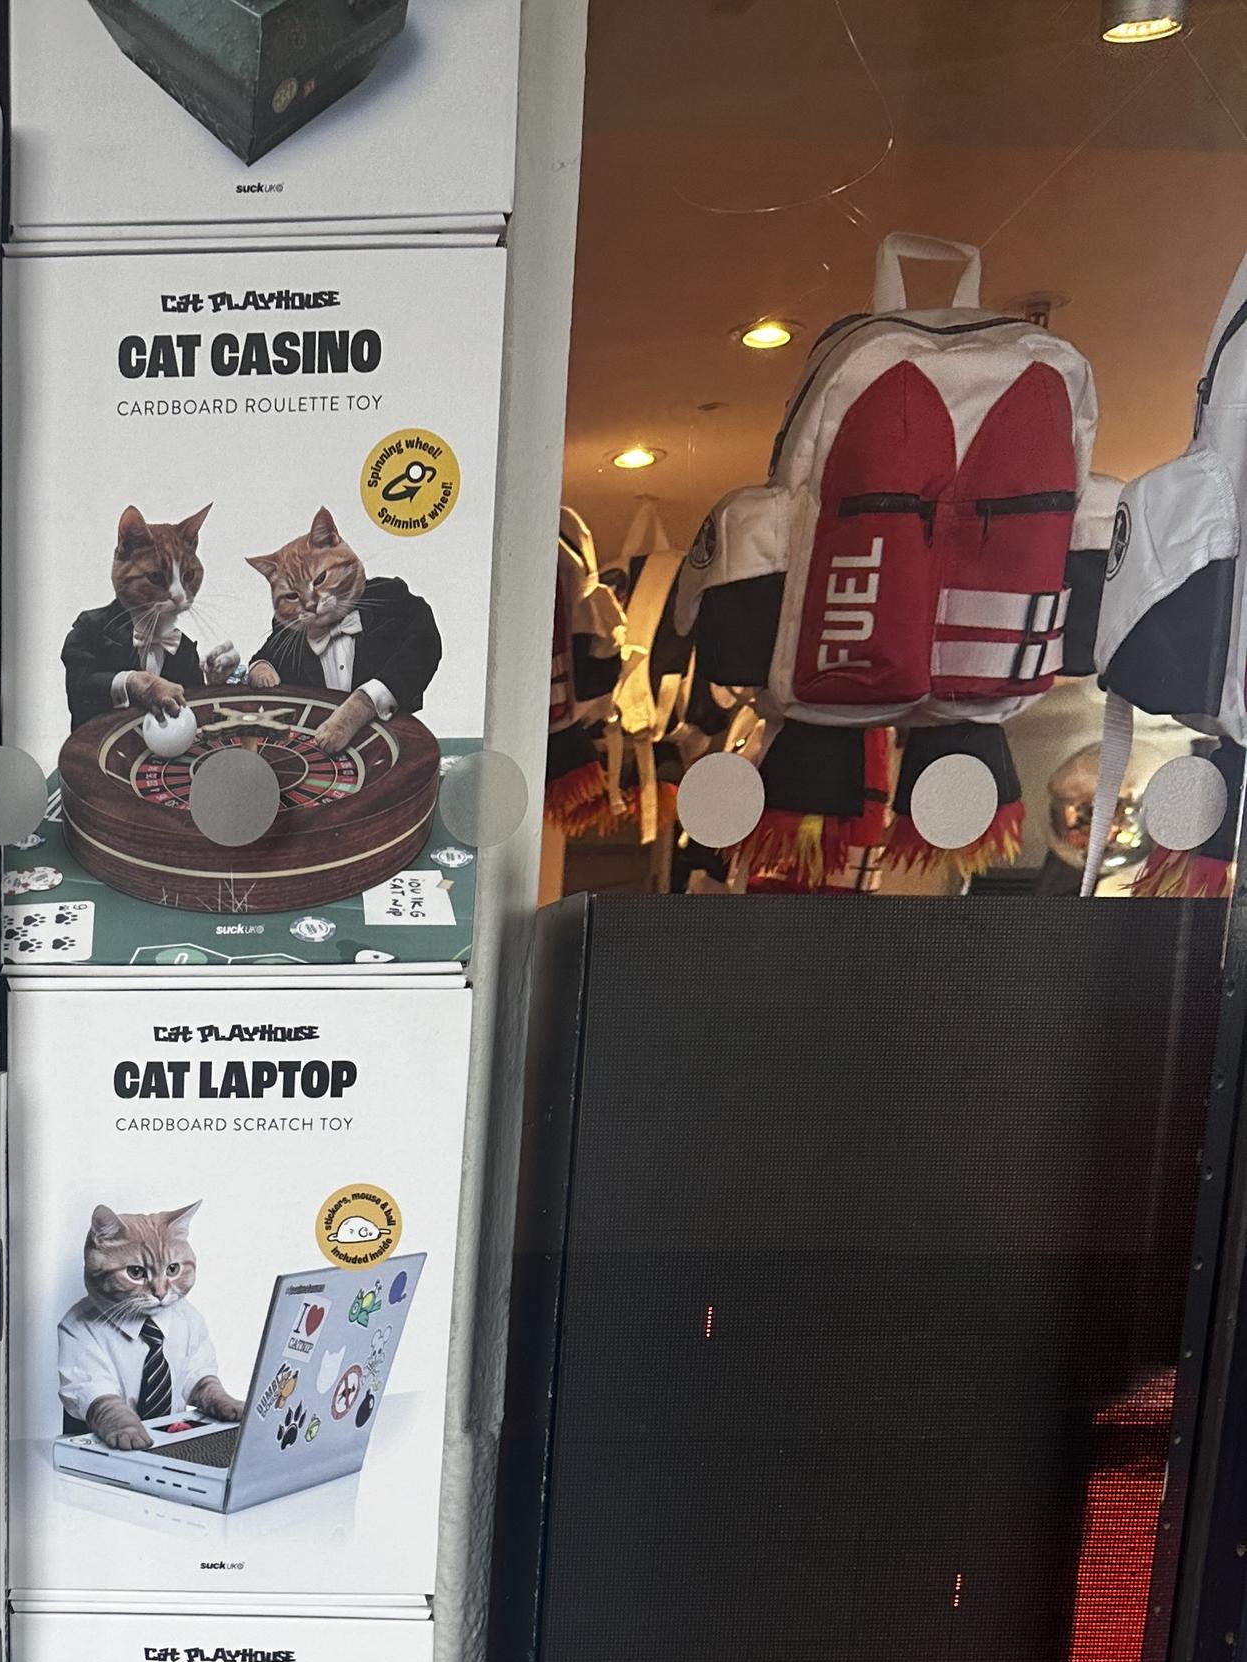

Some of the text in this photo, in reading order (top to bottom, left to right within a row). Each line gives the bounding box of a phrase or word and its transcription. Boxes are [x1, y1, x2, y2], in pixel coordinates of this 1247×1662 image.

[118, 329, 382, 379] CAT CASINO
[117, 395, 383, 416] CARDBOARD ROULETTE TOY
[367, 436, 443, 488] Spinning wheel!
[377, 481, 454, 529] Spinning wheel!
[817, 536, 884, 673] FUEL
[114, 1060, 357, 1099] CAT LAPTOP
[115, 1117, 353, 1131] CARDBOARD SCRATCH TOY
[352, 1193, 381, 1205] mouse
